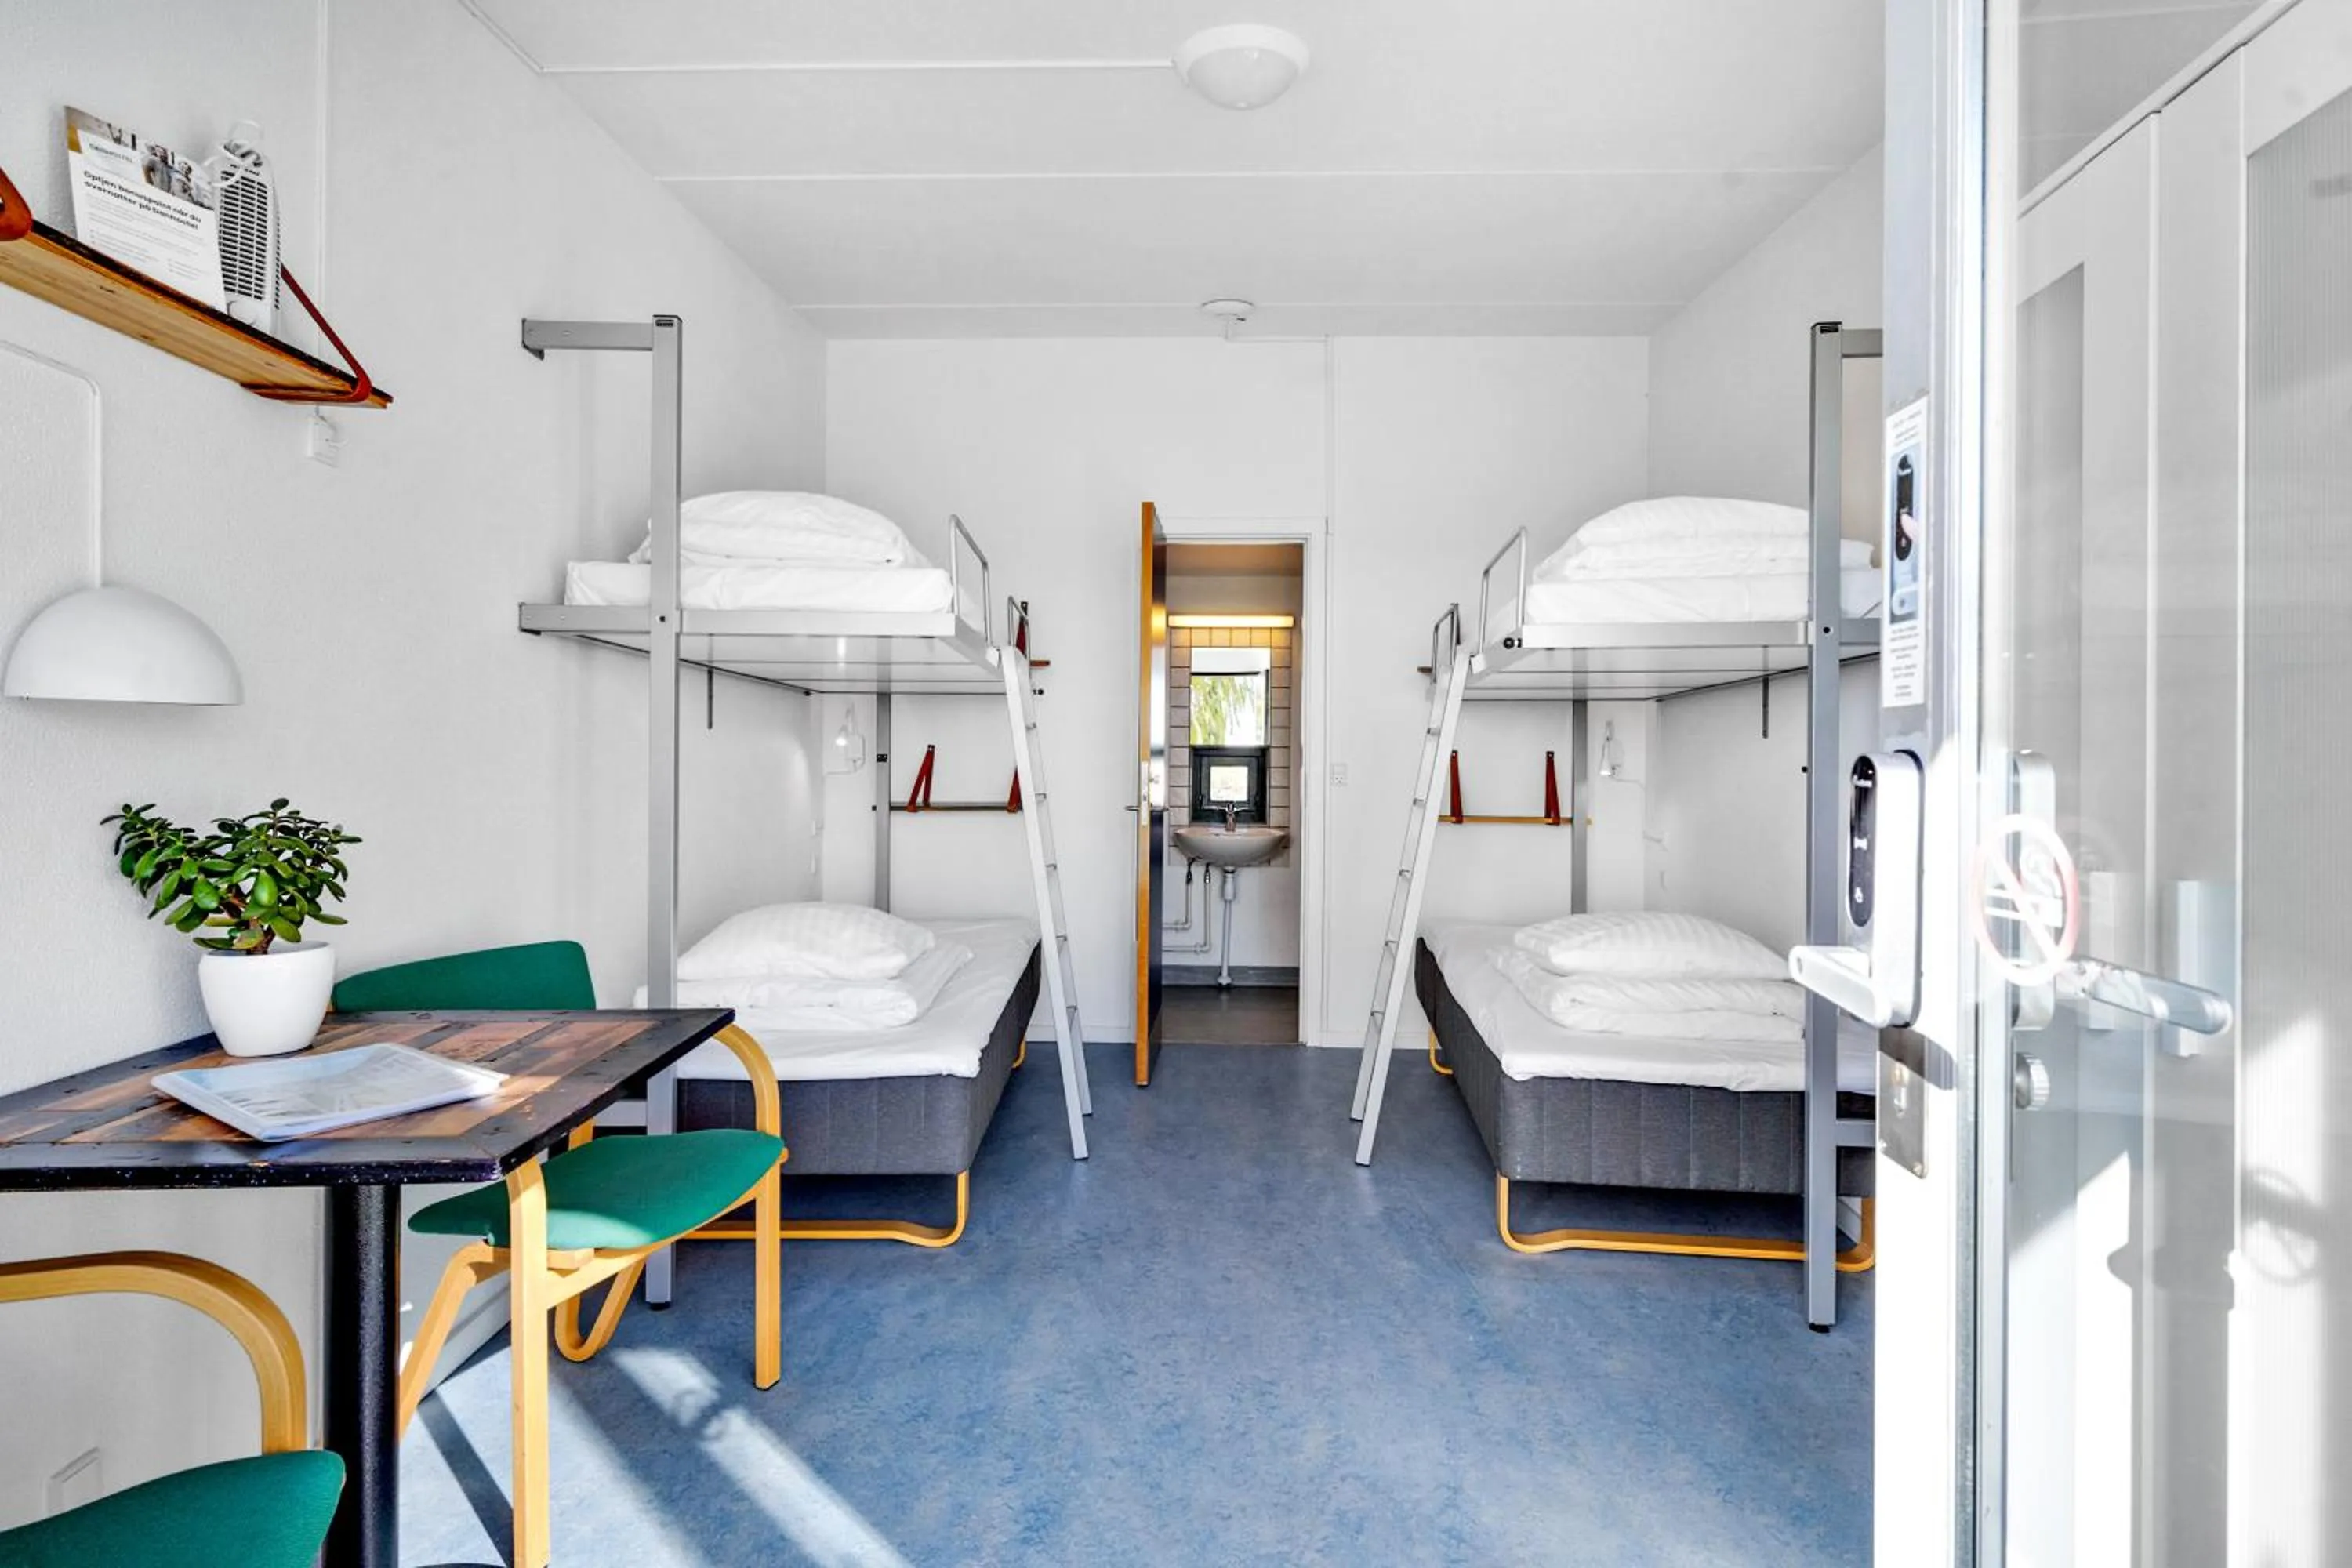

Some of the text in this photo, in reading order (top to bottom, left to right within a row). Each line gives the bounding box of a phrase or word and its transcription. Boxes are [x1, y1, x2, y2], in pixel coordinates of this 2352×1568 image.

[84, 181, 137, 205] overnatter
[84, 170, 117, 189] Optjen
[189, 214, 201, 223] du
